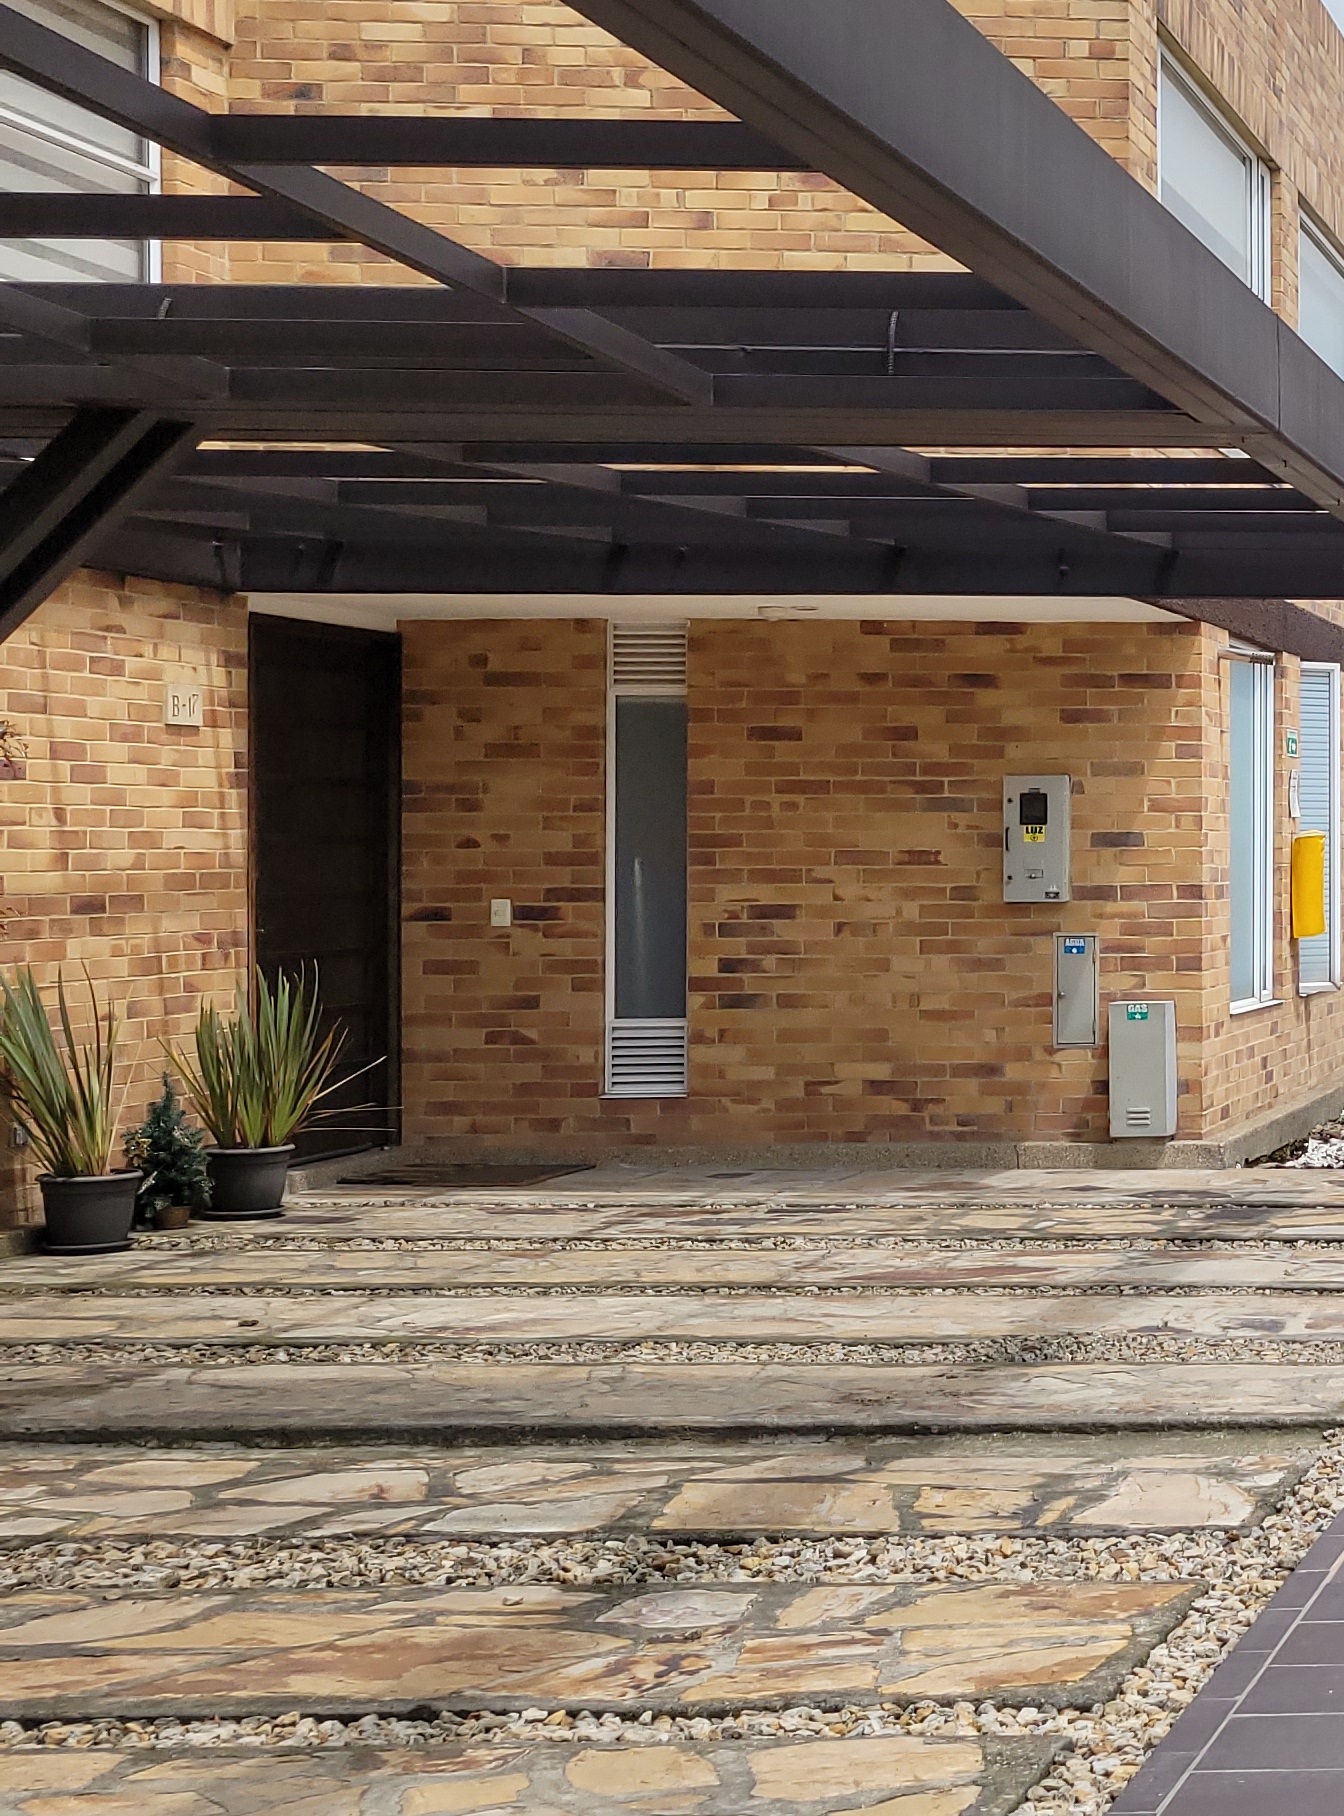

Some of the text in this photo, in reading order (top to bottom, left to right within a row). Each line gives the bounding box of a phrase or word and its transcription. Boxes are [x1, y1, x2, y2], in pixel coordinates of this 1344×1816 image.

[172, 694, 199, 717] B-17
[1025, 826, 1043, 834] LUZ
[1128, 1004, 1148, 1013] GAS
